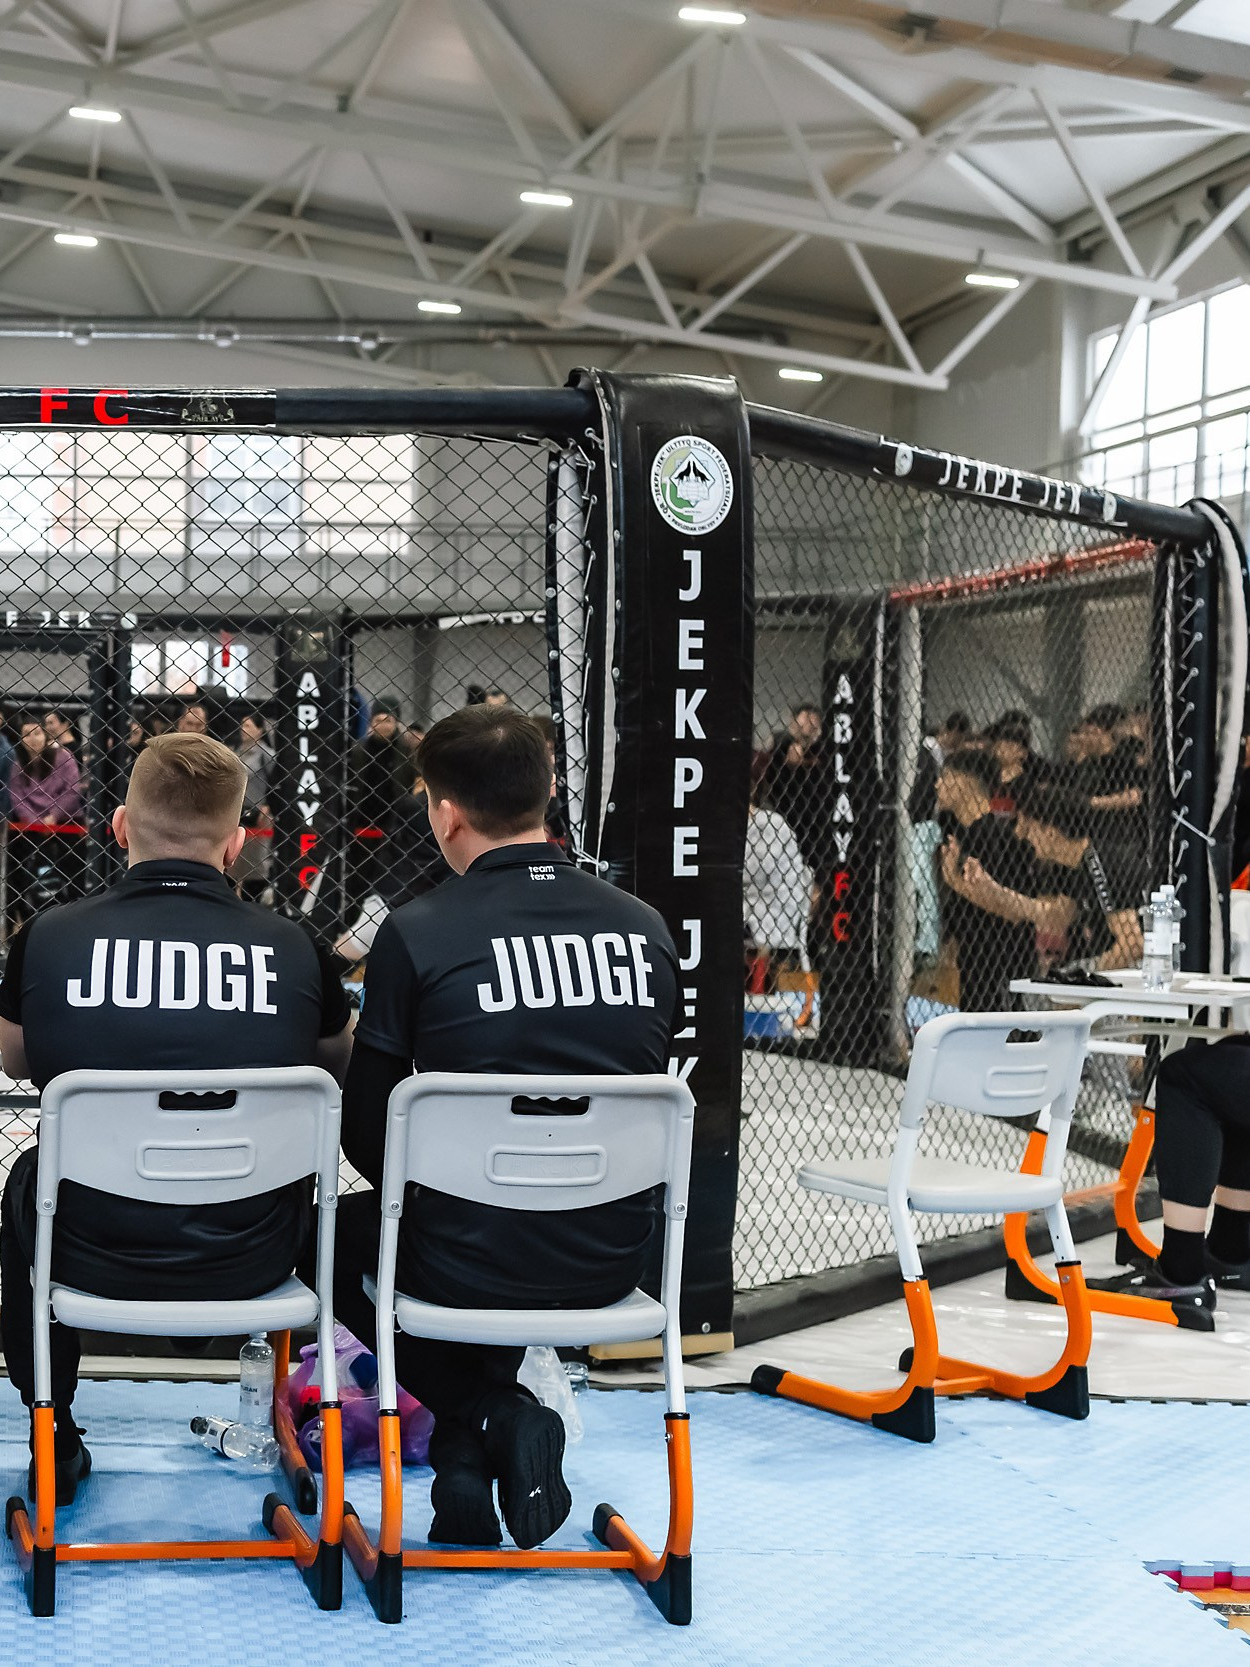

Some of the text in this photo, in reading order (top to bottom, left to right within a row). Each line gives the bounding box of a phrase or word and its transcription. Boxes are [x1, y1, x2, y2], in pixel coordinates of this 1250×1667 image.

[40, 387, 129, 425] FC
[937, 452, 1082, 514] JEKPE JEK
[297, 672, 321, 827] ABLAY
[673, 549, 708, 877] JEKPE
[832, 673, 854, 942] ABLAY FC
[528, 865, 554, 873] team
[66, 938, 278, 1015] JUDGE
[476, 932, 655, 1013] JUDGE
